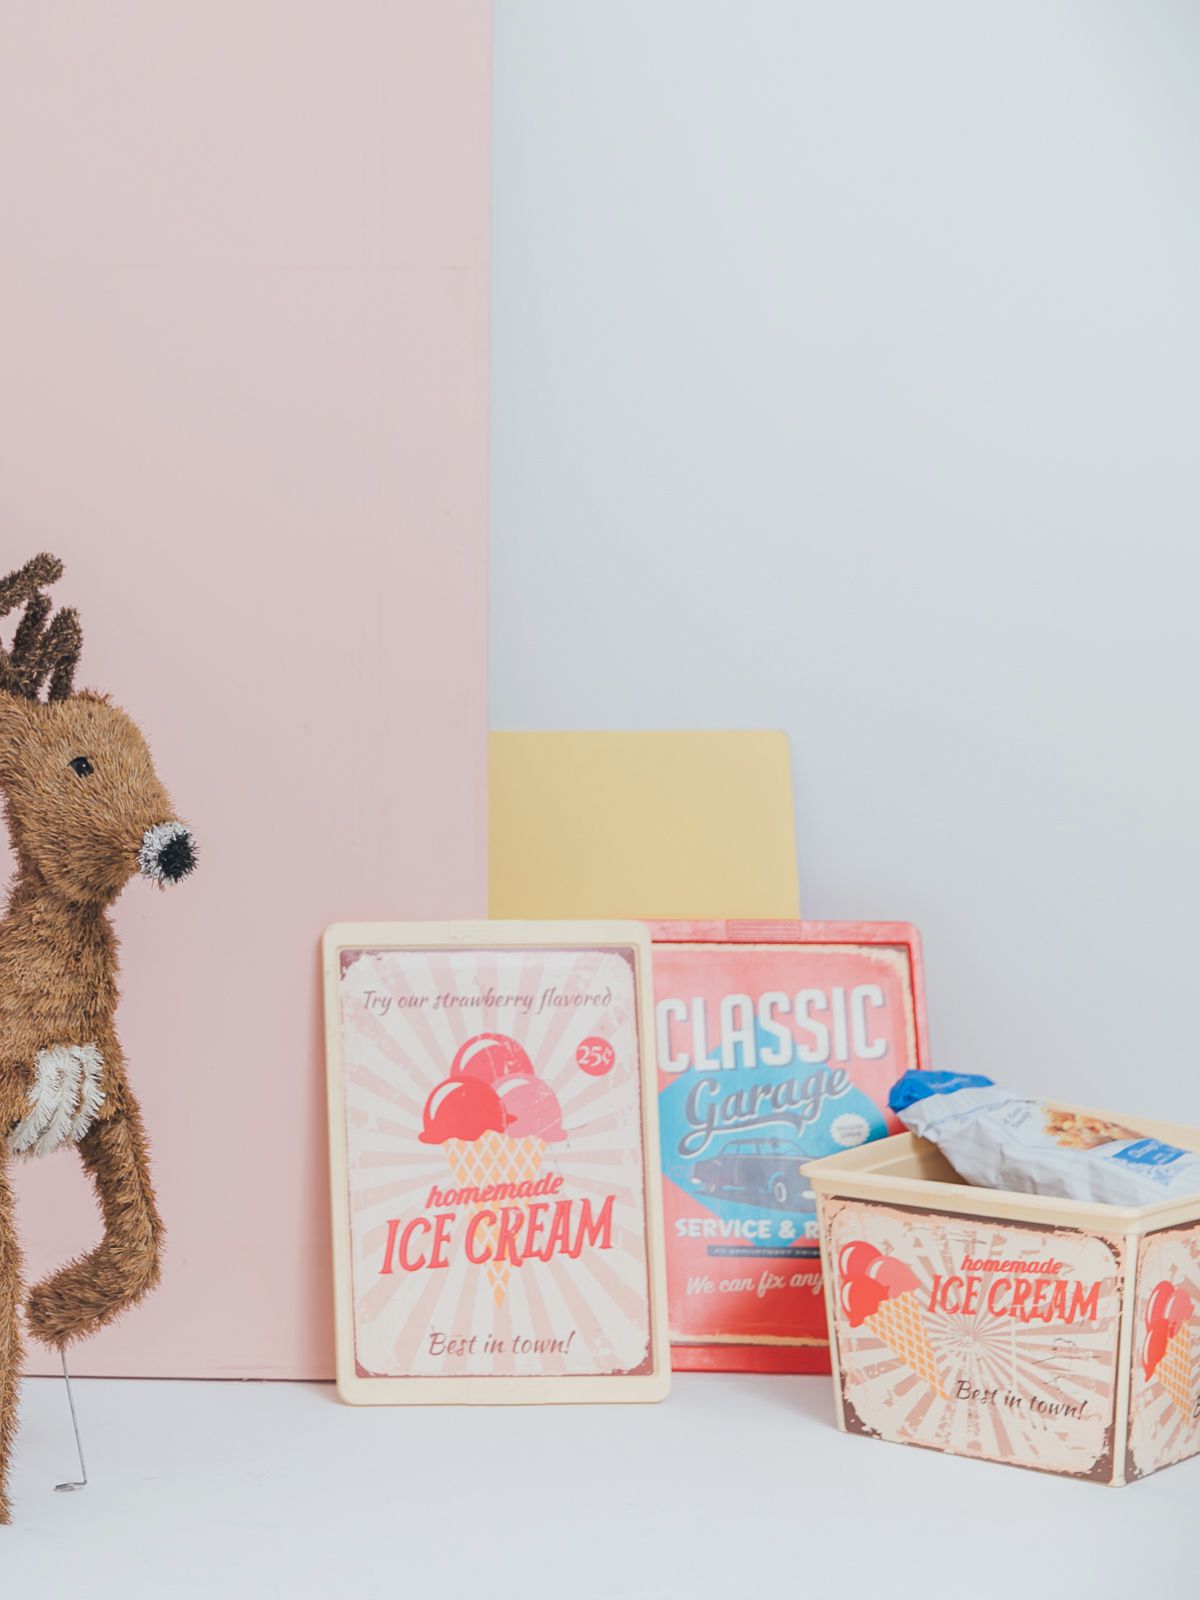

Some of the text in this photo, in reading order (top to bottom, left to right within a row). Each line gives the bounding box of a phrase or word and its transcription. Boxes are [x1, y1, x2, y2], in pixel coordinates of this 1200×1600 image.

[363, 986, 613, 1016] Try our strawberry flavored
[656, 984, 888, 1073] CLASSIC
[680, 1068, 853, 1150] Garage
[425, 1172, 565, 1209] homemade
[379, 1194, 616, 1275] ICE CREAM
[675, 1217, 772, 1239] SERVICE
[778, 1219, 796, 1239] &
[960, 1254, 1063, 1275] homemade
[686, 1276, 715, 1295] We
[719, 1278, 755, 1292] can
[757, 1270, 785, 1298] fix
[927, 1274, 1102, 1325] ICE CREAM
[428, 1331, 576, 1356] Best in town!
[956, 1380, 1088, 1420] Best in town!
